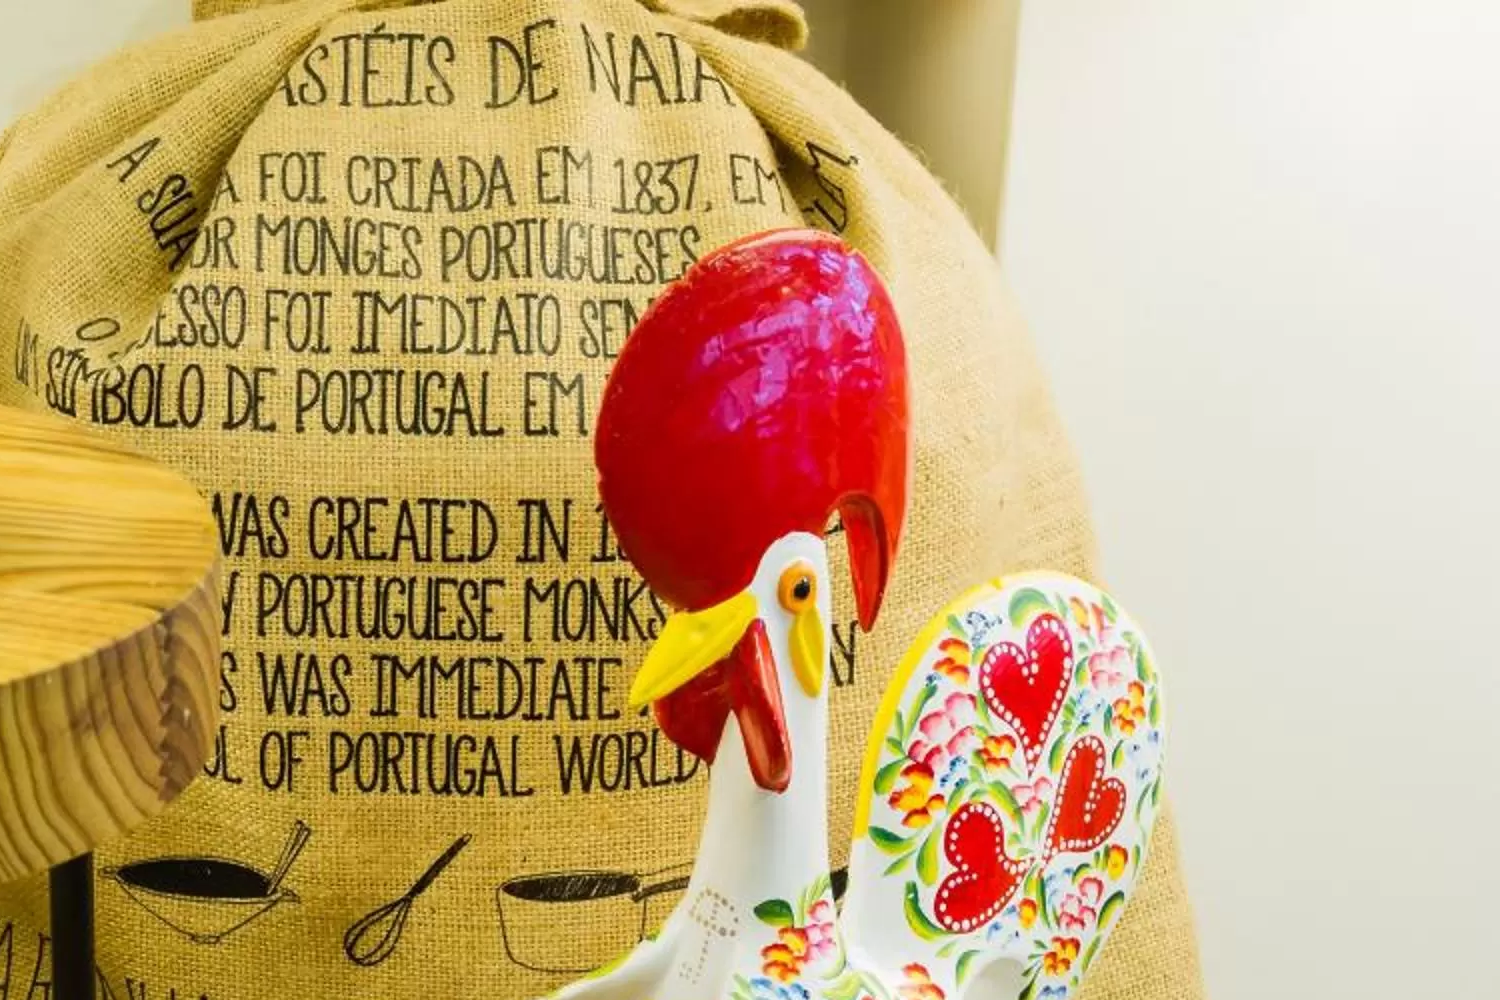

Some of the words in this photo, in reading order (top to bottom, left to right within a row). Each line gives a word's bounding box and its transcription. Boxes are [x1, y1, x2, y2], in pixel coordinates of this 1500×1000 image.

[485, 20, 559, 109] DE
[581, 23, 737, 107] NATA
[259, 151, 327, 204] FOI
[347, 154, 514, 213] CRIADA
[536, 146, 594, 208] EM
[611, 154, 713, 214] 1837,
[730, 153, 788, 213] EM
[137, 174, 199, 272] SUA
[256, 214, 422, 280] MONGES
[440, 217, 701, 285] PORTUGUESES
[264, 289, 331, 354] FOI
[350, 291, 561, 359] IMEDIATO
[222, 367, 276, 433] DE
[296, 369, 505, 438] PORTUGAL
[521, 371, 588, 437] EM
[309, 496, 498, 562] CREATED
[515, 498, 572, 563] IN
[258, 572, 505, 642] PORTUGUESE
[256, 651, 353, 718] WAS
[370, 653, 623, 721] IMMEDIATE
[260, 731, 310, 793] OF
[329, 731, 534, 797] PORTUGAL
[556, 728, 699, 795] WORLD
